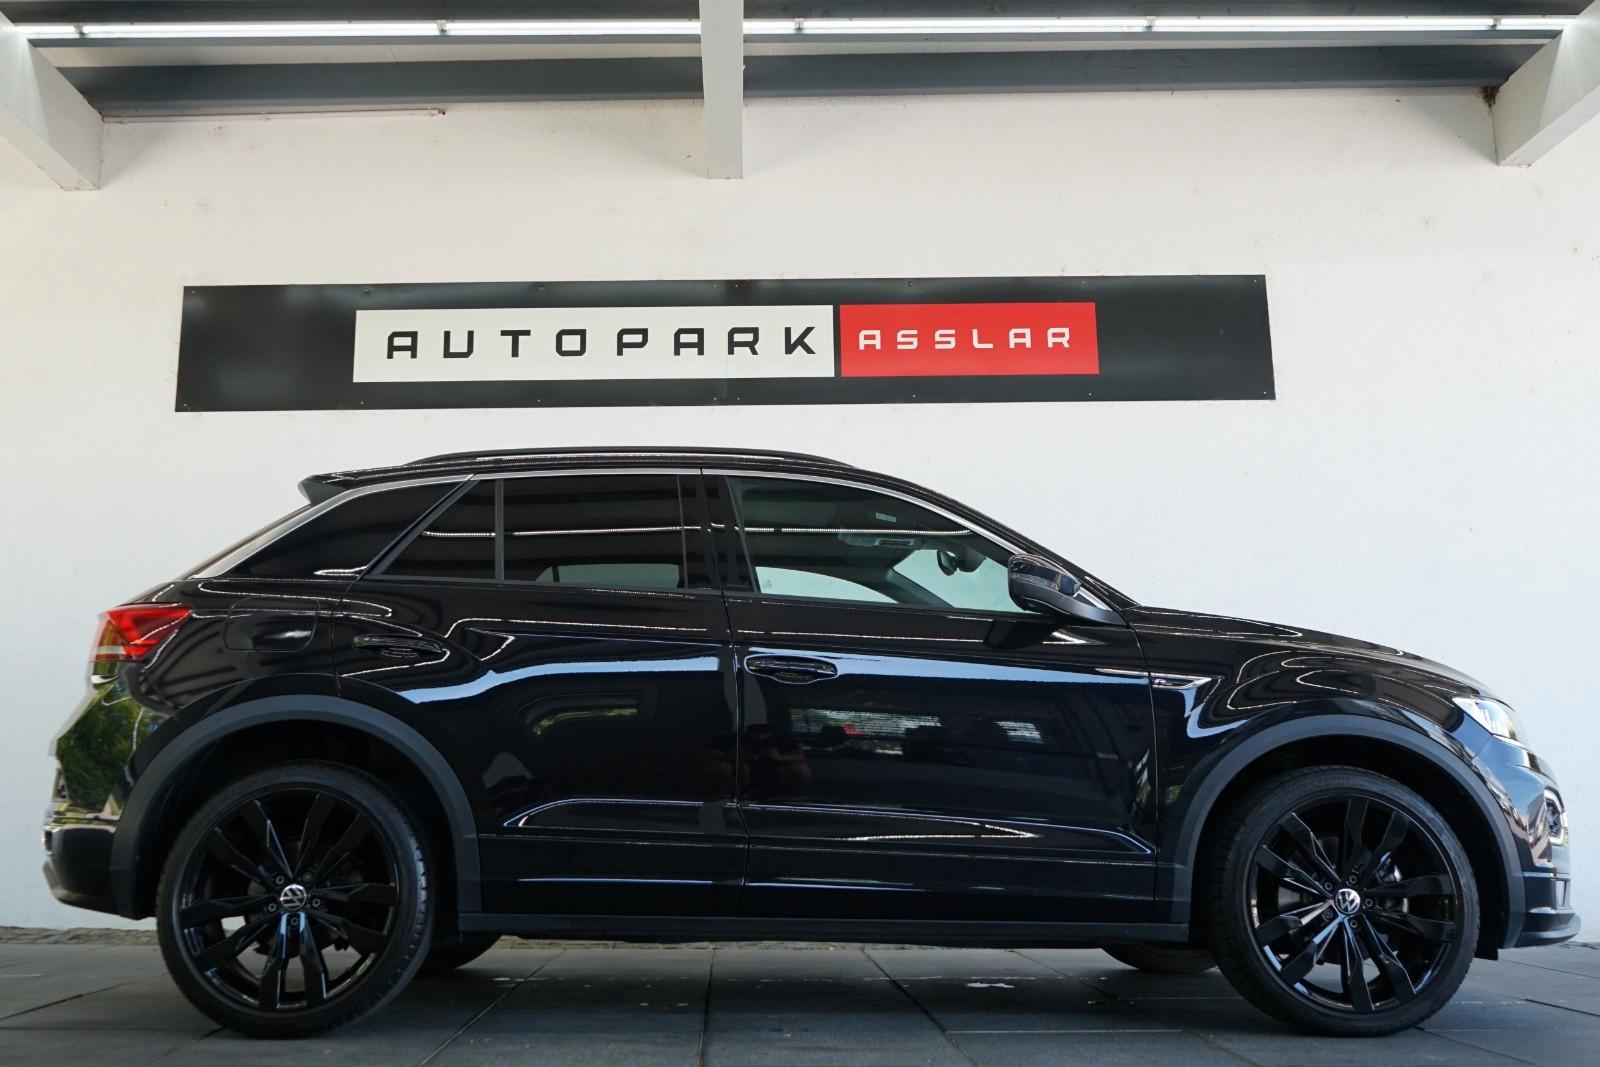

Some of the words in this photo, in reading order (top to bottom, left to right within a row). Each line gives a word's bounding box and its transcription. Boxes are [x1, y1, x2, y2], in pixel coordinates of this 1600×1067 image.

[386, 326, 817, 359] AUTOPARK
[858, 327, 1071, 350] ASSLAR
[1336, 889, 1360, 914] VW
